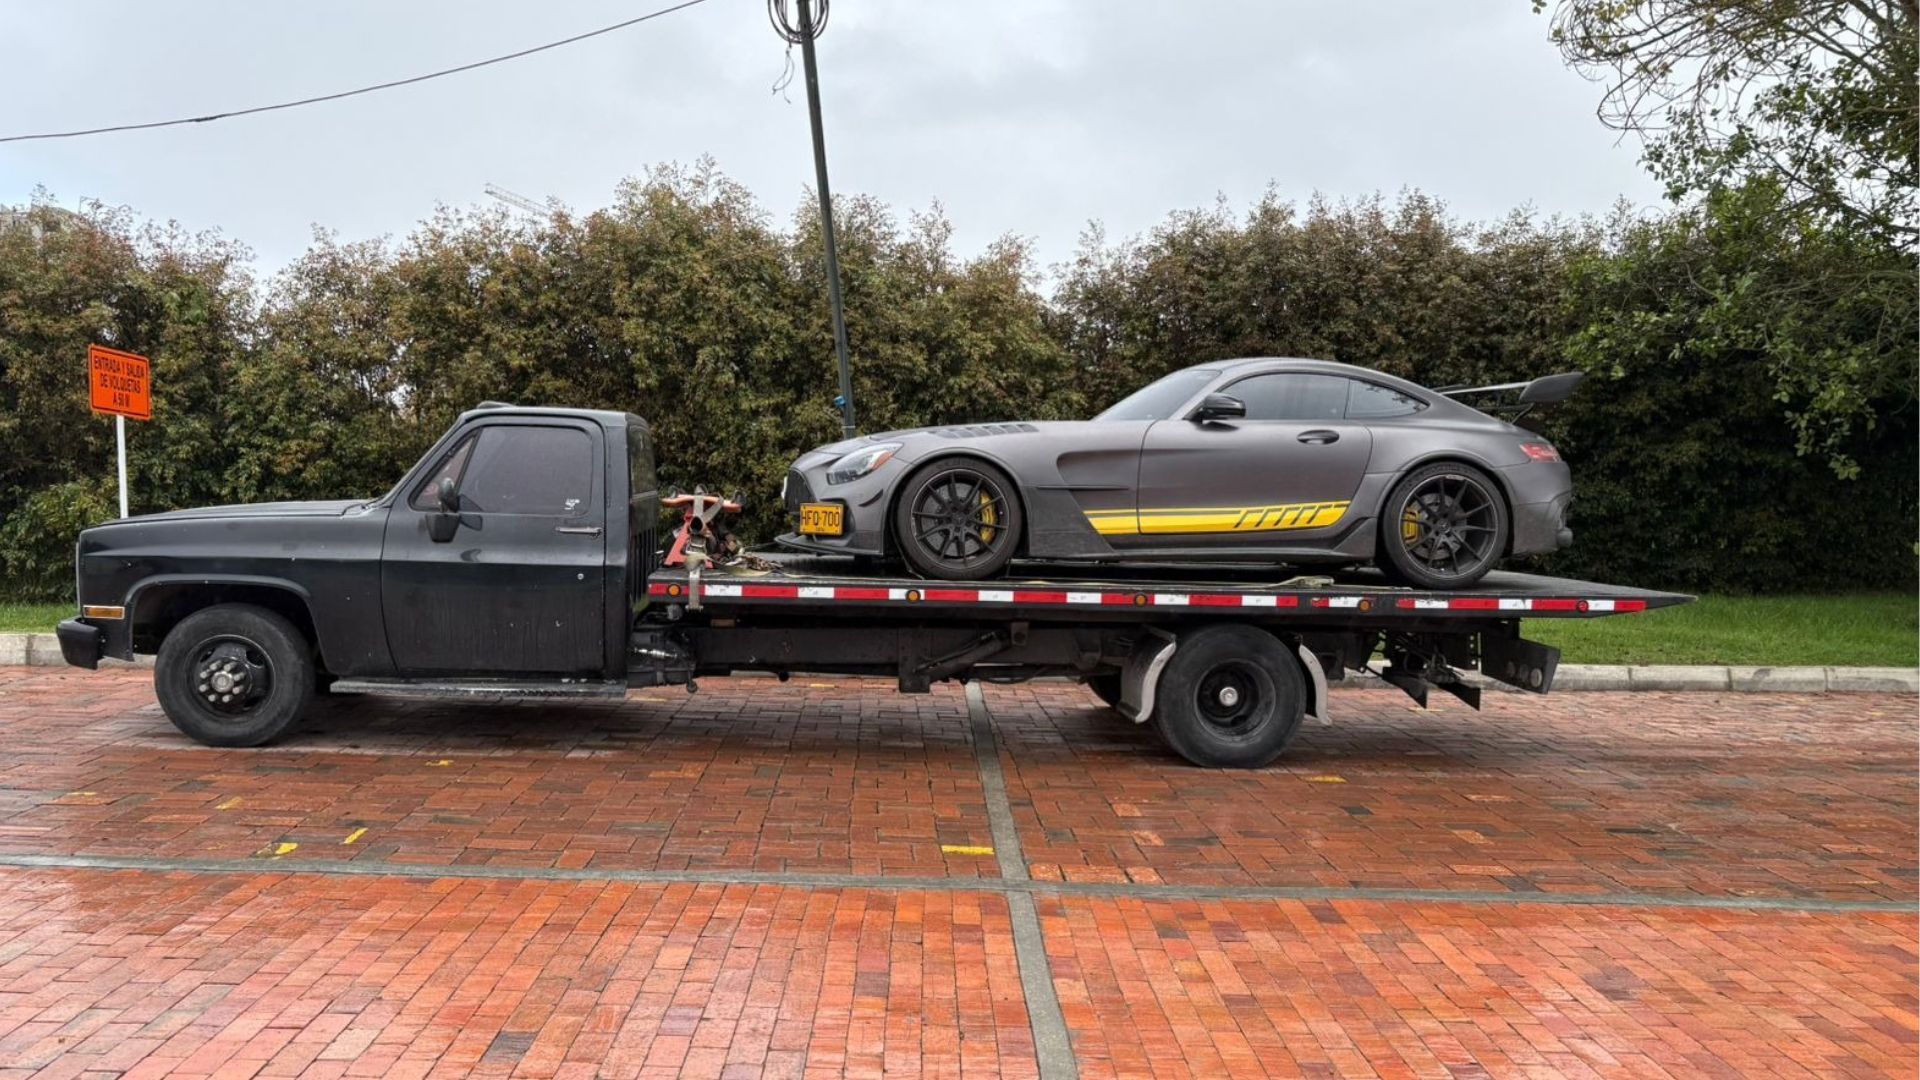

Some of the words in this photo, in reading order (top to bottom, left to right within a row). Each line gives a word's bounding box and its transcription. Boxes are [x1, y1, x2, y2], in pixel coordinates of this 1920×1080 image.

[94, 355, 121, 373] ENTRADA
[126, 361, 145, 378] SALIDA
[100, 373, 108, 388] DE
[109, 375, 141, 394] VOLQUETAS
